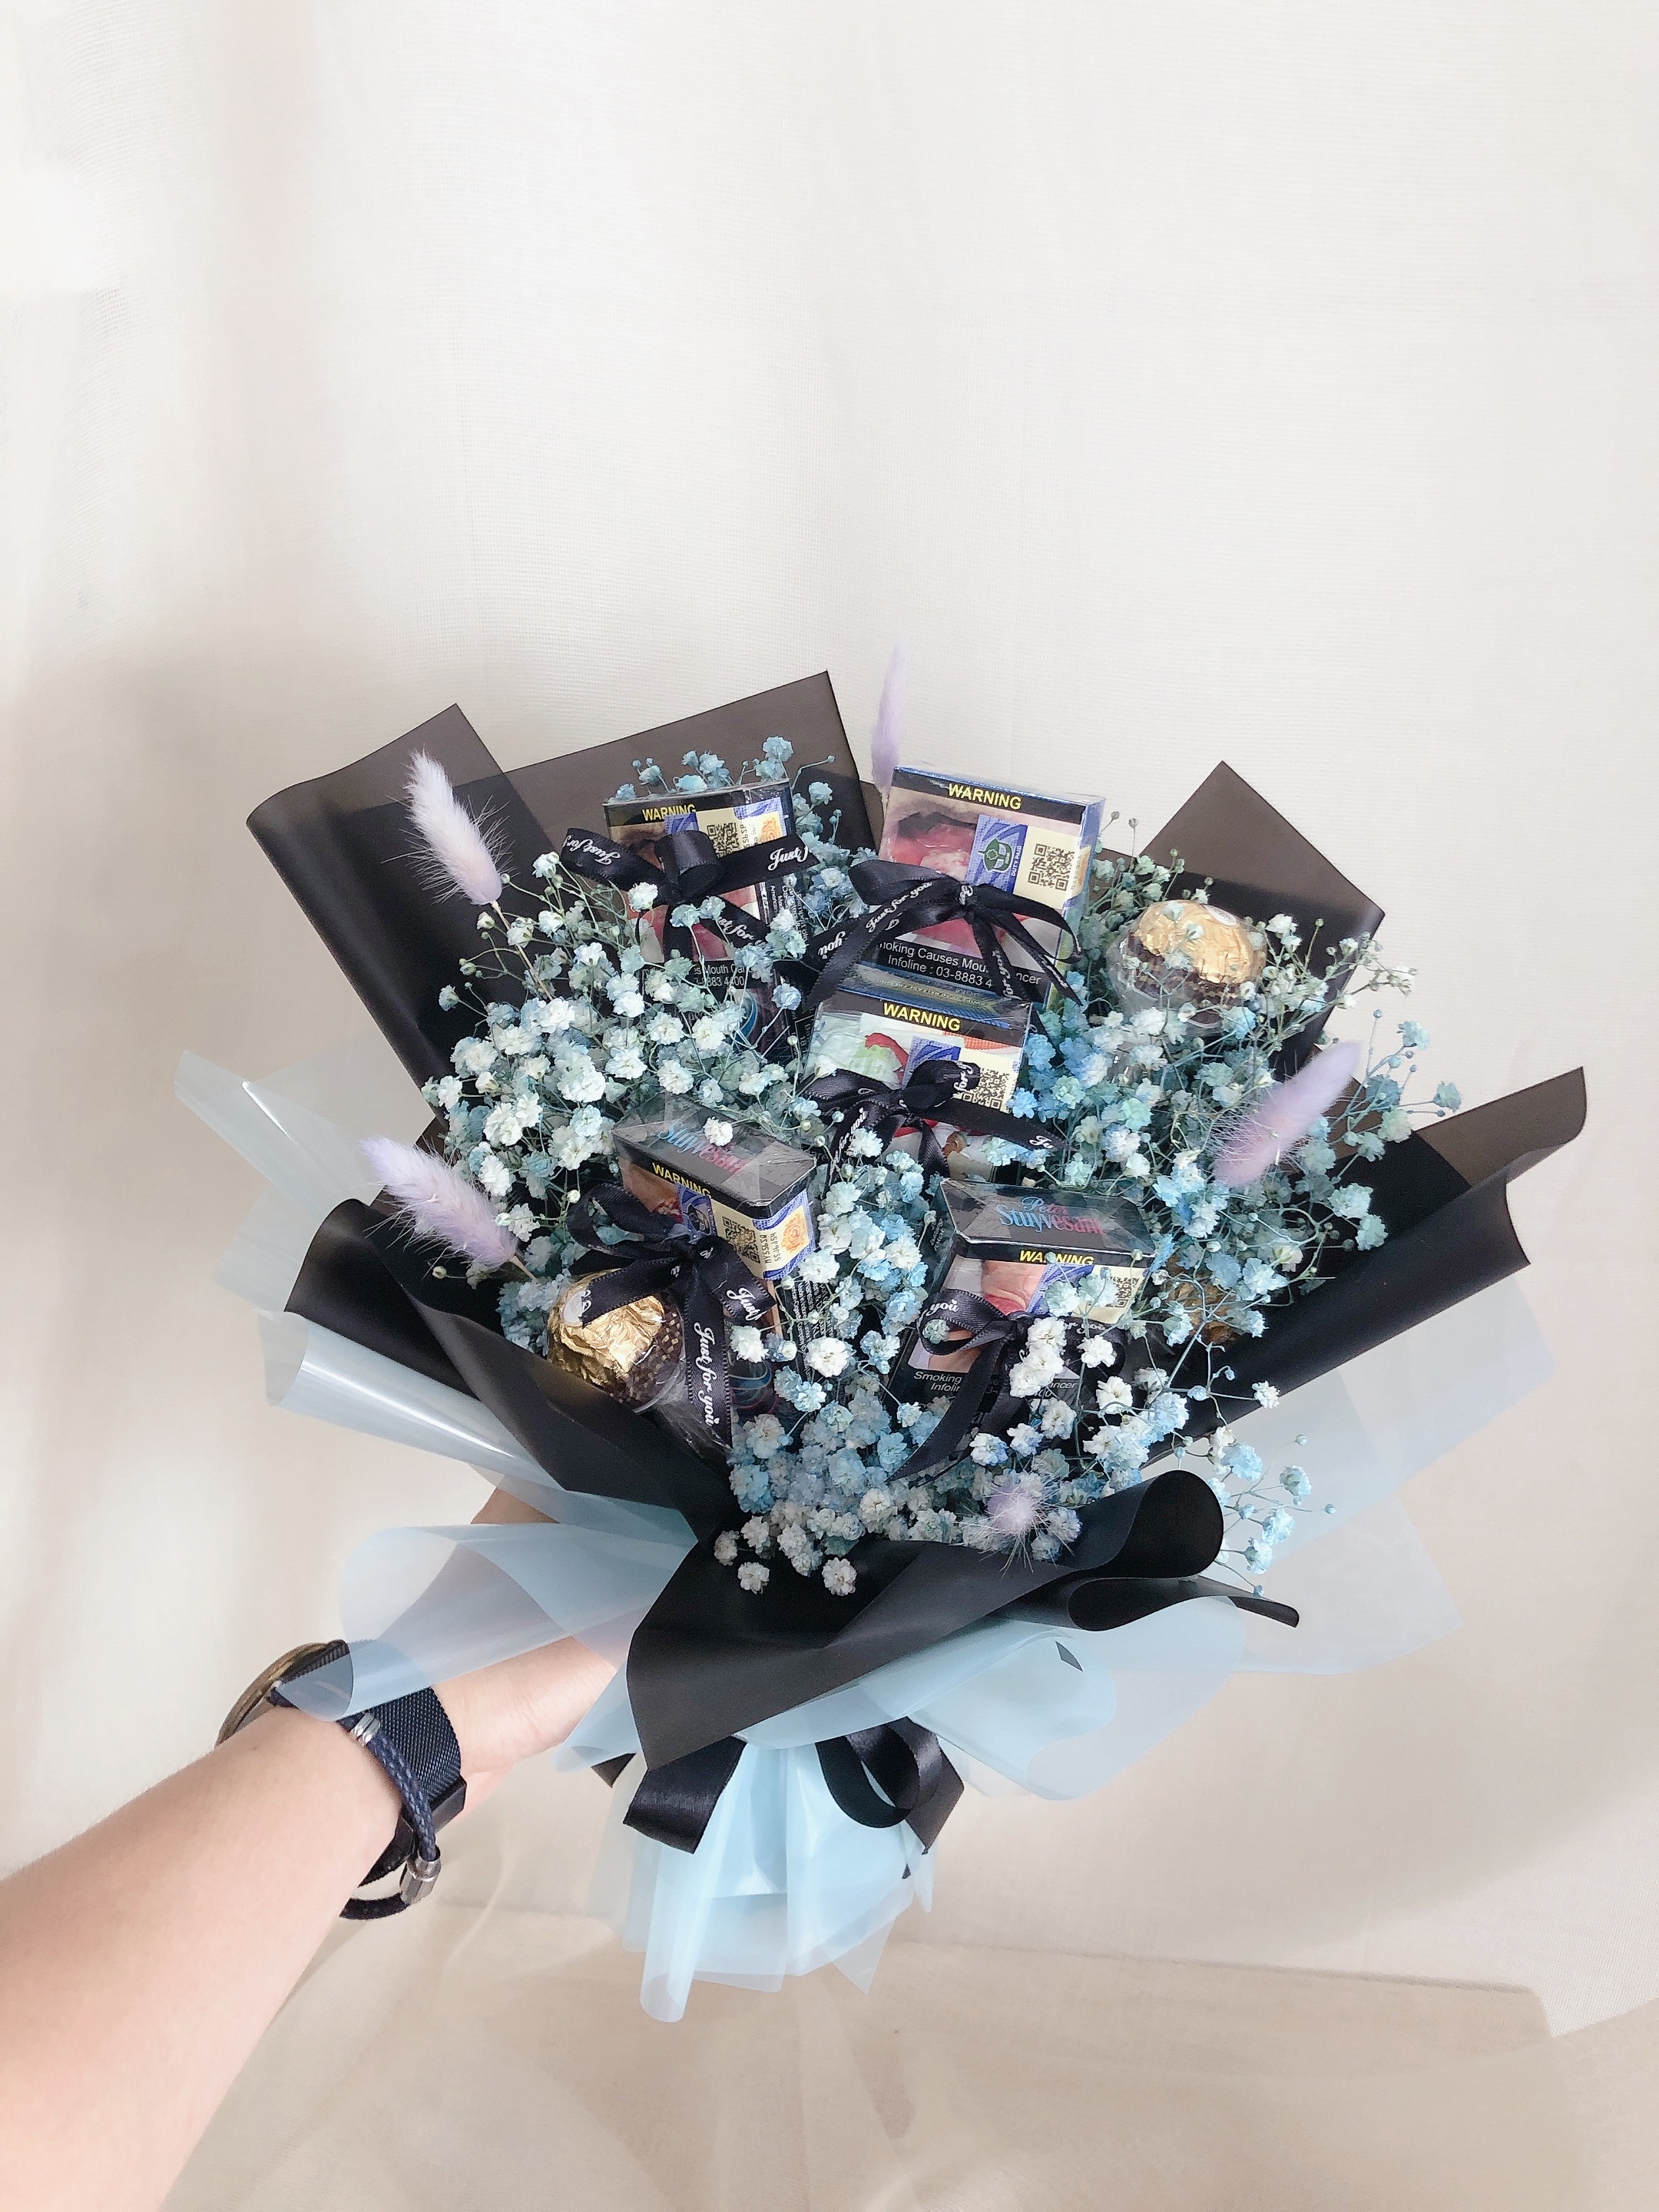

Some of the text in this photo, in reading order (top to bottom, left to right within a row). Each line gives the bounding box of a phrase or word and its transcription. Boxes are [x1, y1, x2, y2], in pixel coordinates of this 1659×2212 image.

[949, 783, 1022, 810] WARNING
[642, 804, 697, 821] WARNING
[583, 844, 621, 865] Just
[768, 847, 802, 871] Just
[909, 882, 932, 899] you
[724, 925, 755, 939] for
[818, 931, 846, 959] you
[880, 941, 914, 959] oking
[917, 948, 959, 966] Causes
[962, 958, 988, 973] Mou
[1016, 972, 1041, 985] ncer
[888, 955, 926, 972] Infoline
[935, 966, 982, 985] 03-8883
[724, 975, 745, 986] 400
[883, 1002, 961, 1031] WARNING
[652, 1162, 713, 1199] WARNING
[1022, 1196, 1068, 1215] Peter
[995, 1204, 1107, 1233] Stuyvesant
[1019, 1250, 1094, 1265] WANING
[727, 1287, 761, 1316] Just
[929, 1299, 959, 1317] you
[694, 1322, 720, 1427] Just for you
[914, 1371, 962, 1385] Smoking
[931, 1382, 960, 1391] Infoli
